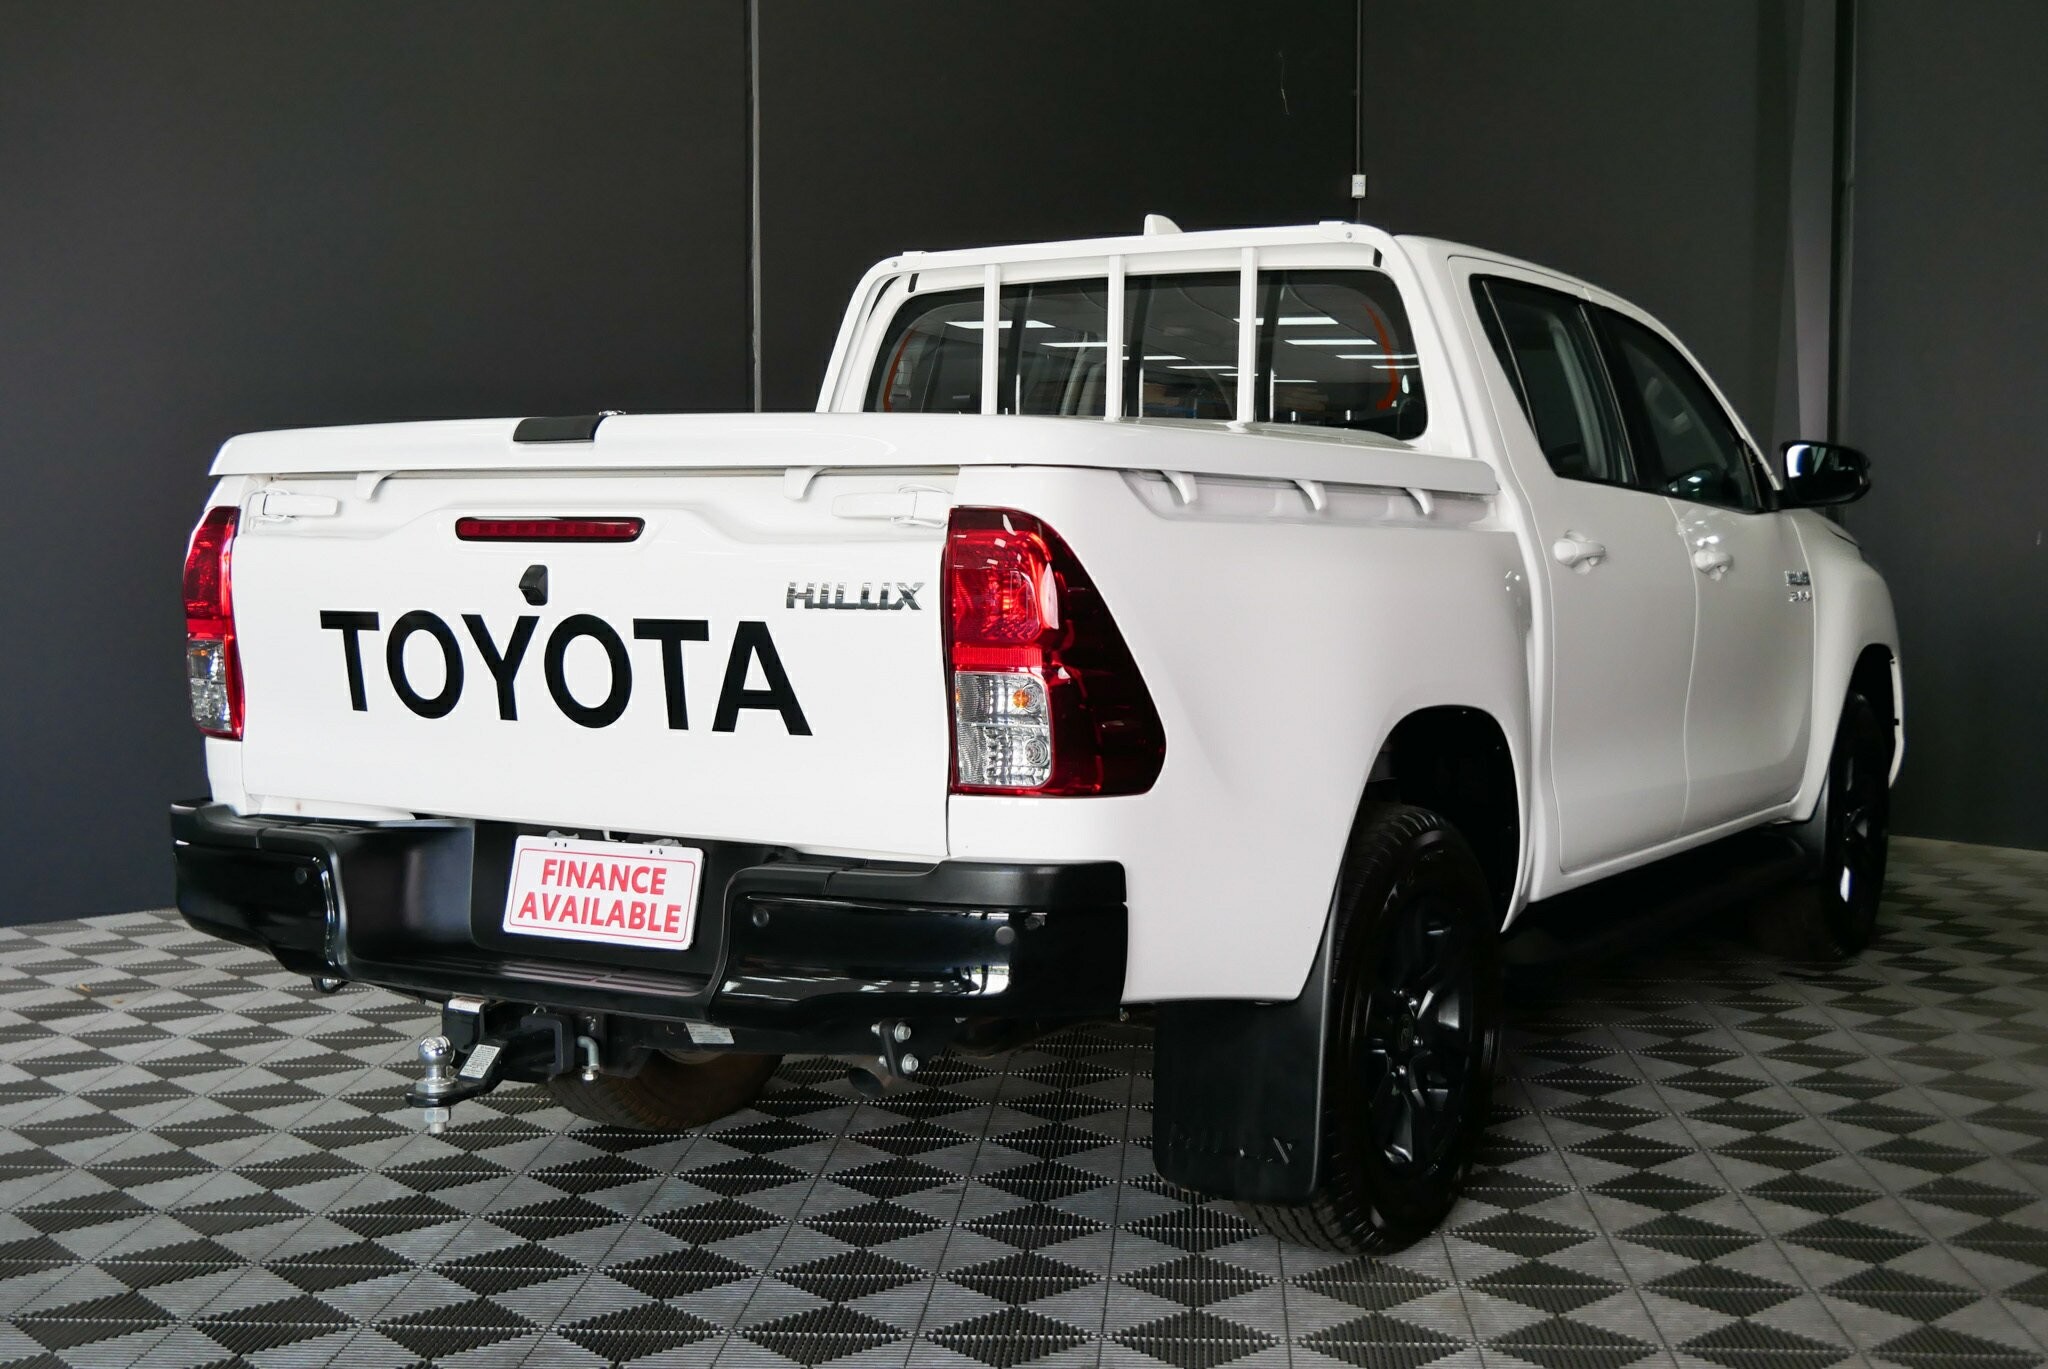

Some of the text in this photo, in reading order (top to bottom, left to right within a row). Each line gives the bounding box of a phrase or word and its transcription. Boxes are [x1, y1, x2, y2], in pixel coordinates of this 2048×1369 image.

[786, 582, 925, 610] HILUX
[320, 610, 813, 736] TOYOTA
[541, 858, 667, 896] FINANCE
[518, 891, 682, 934] AVAILABLE
